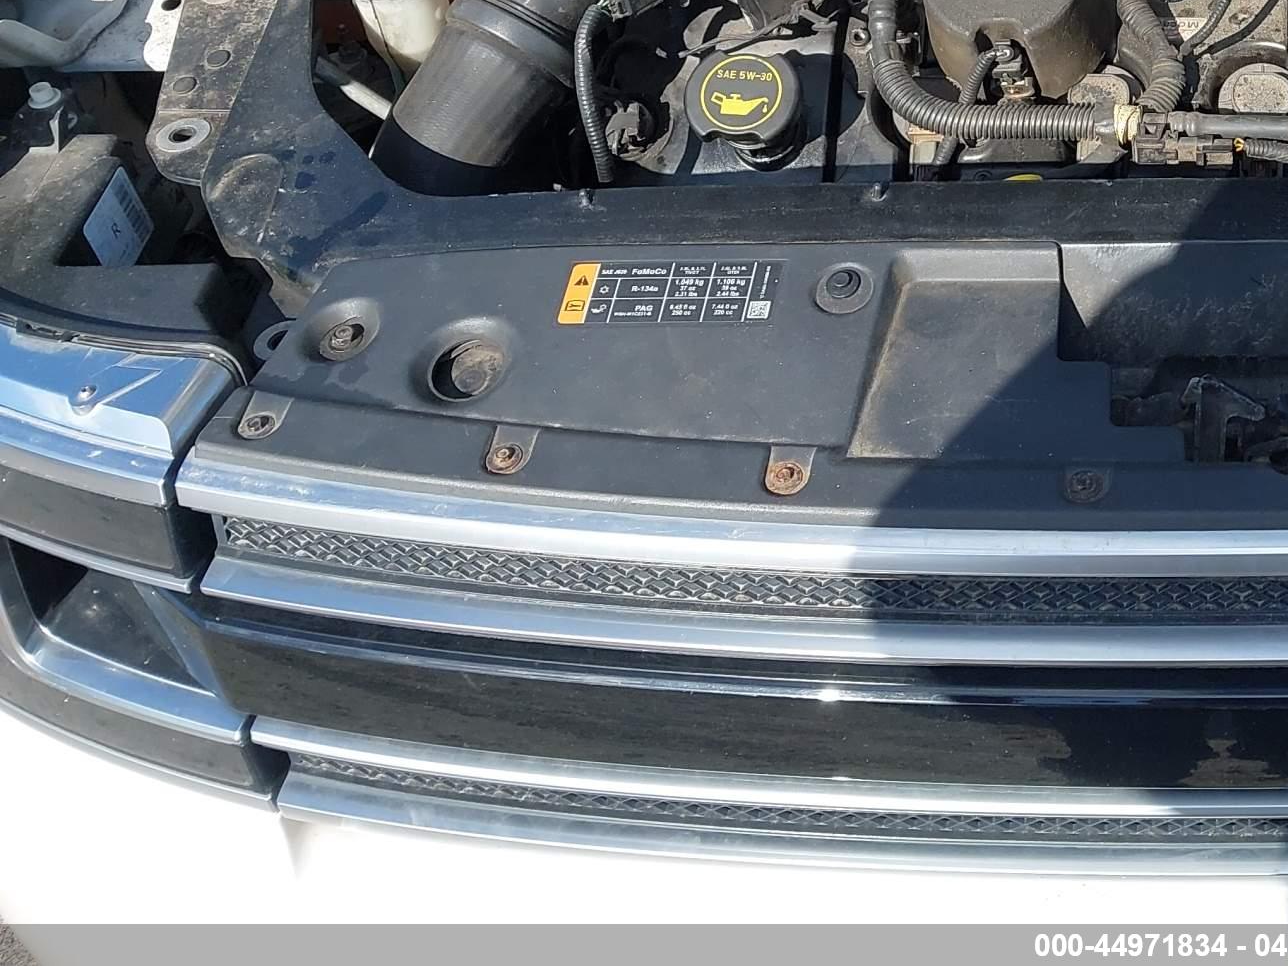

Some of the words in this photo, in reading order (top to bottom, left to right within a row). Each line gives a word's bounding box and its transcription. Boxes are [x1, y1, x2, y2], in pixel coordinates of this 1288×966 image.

[716, 69, 737, 80] SAE
[739, 70, 773, 82] 5W-30
[694, 278, 705, 286] kg
[736, 278, 746, 286] kg
